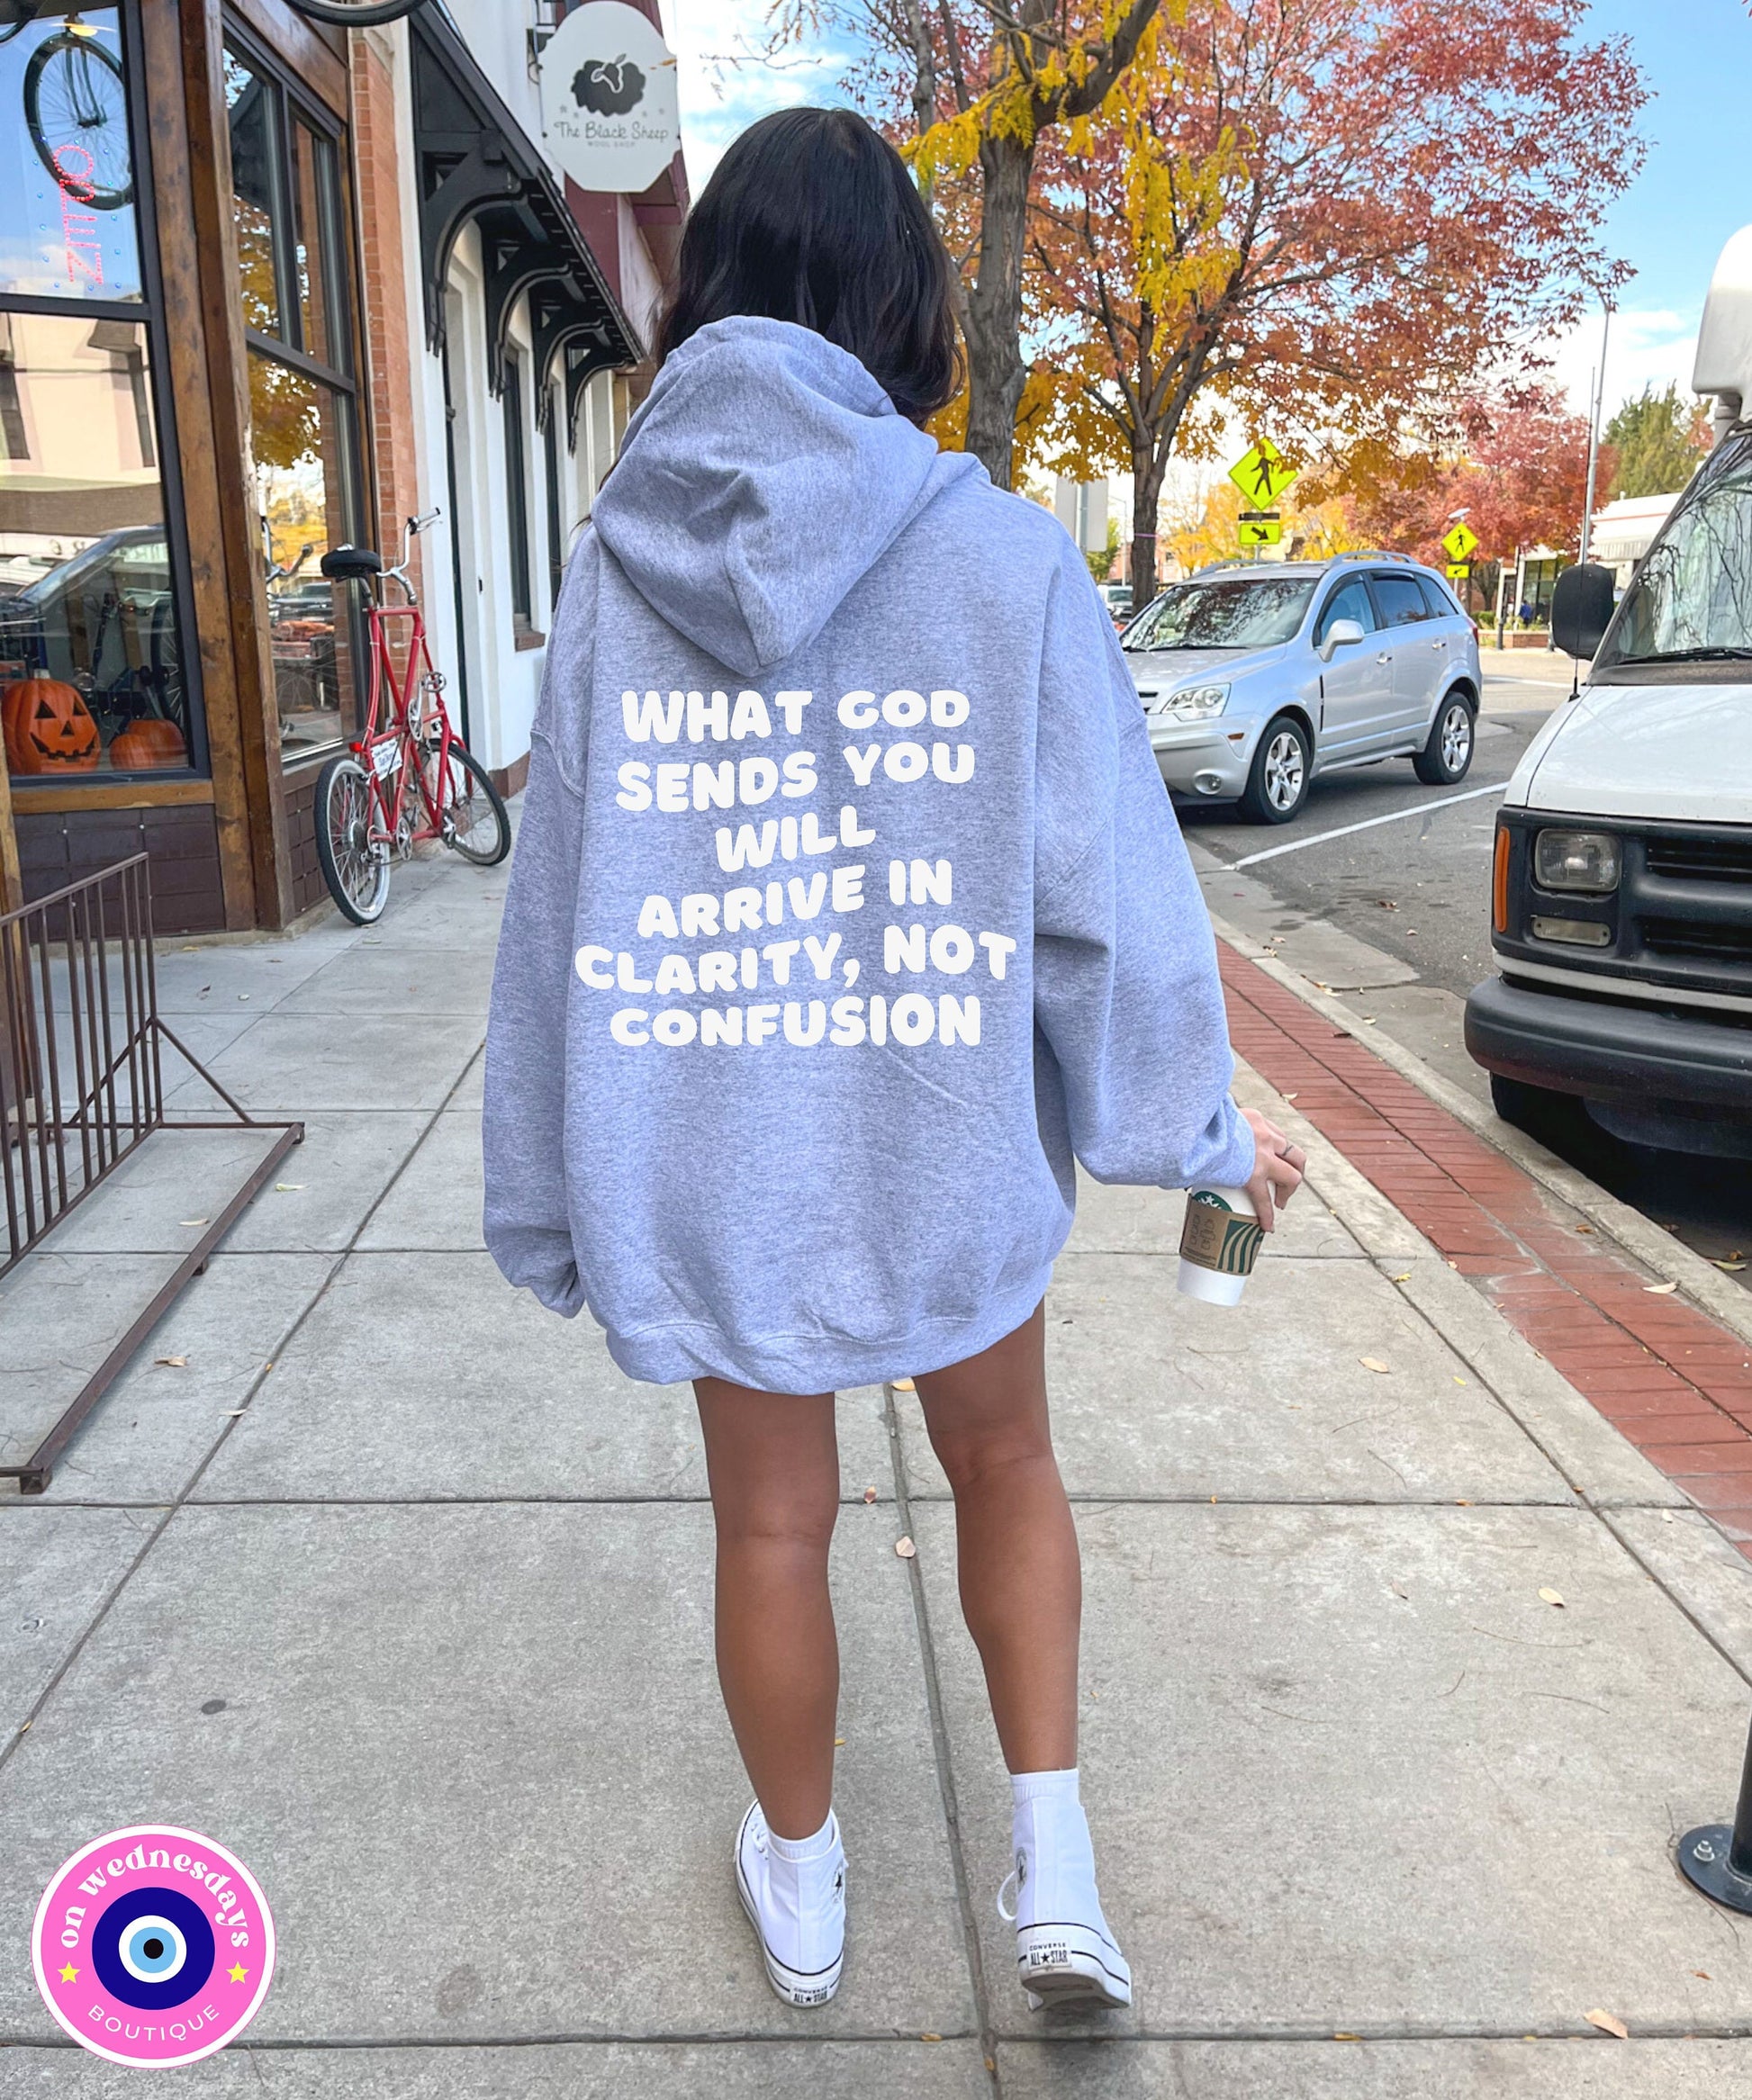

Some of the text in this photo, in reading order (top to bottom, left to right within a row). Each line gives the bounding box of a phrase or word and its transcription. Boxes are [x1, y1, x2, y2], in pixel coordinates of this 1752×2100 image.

[554, 121, 669, 142] The Black Sheep
[53, 144, 104, 284] OPEN
[621, 689, 971, 744] WHAT GOD
[616, 742, 975, 812] SENDS YOU
[715, 805, 876, 872] WILL
[637, 859, 953, 939] ARRIVE IN
[574, 924, 1016, 995] CLARITY, NOT
[610, 993, 981, 1047] CONFUSION
[1029, 1942, 1067, 1951] CONVERSE
